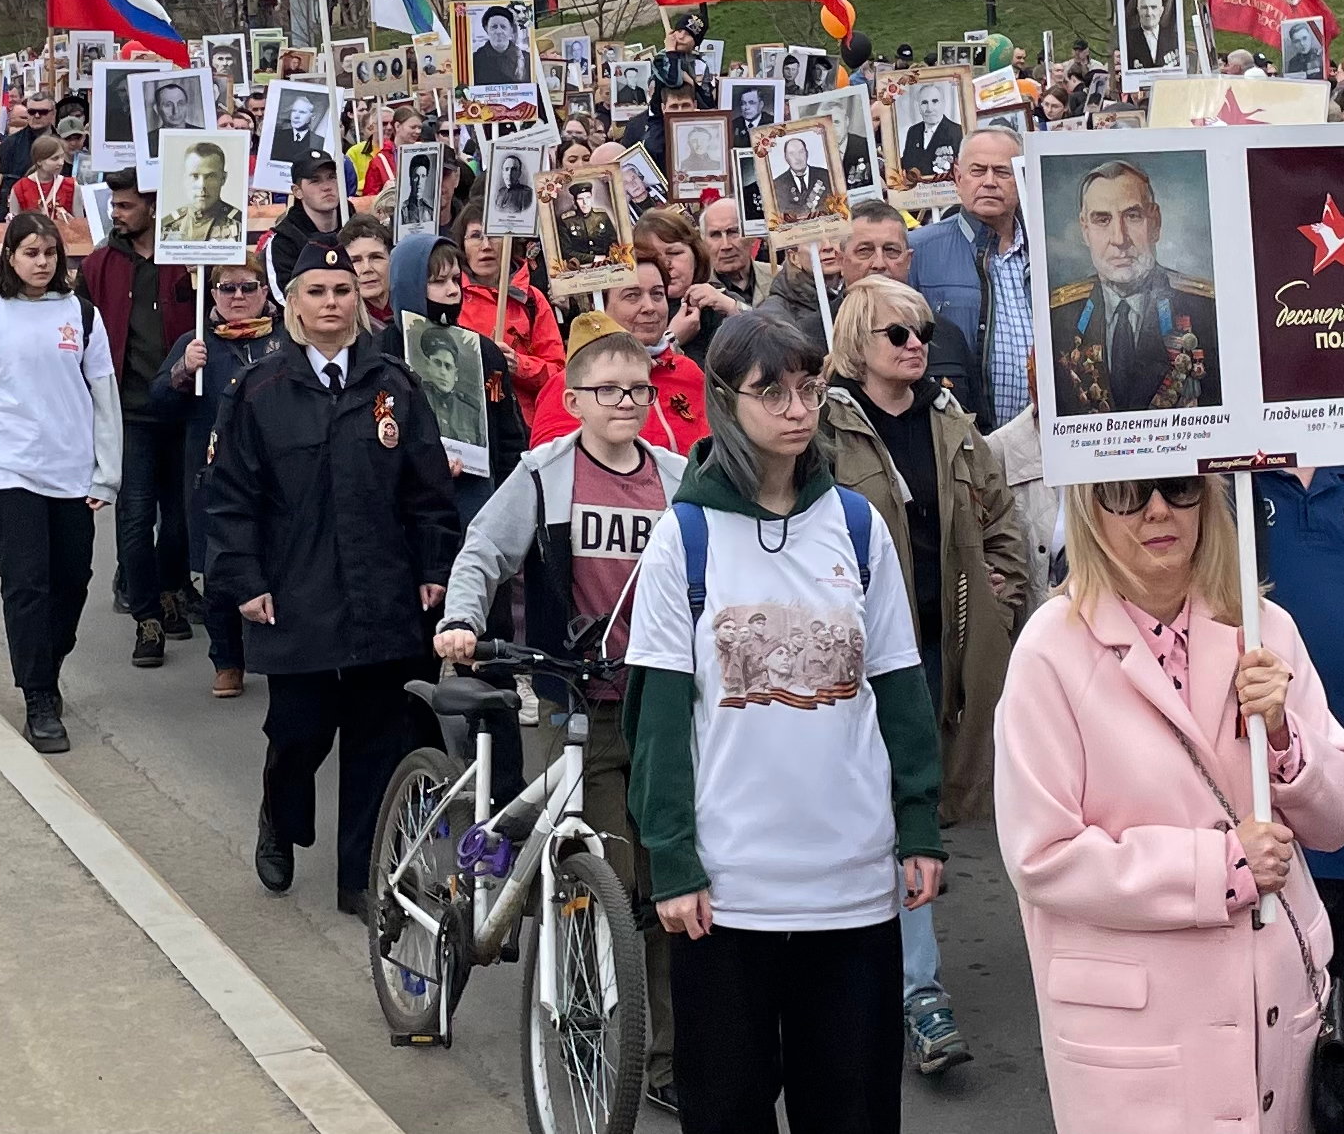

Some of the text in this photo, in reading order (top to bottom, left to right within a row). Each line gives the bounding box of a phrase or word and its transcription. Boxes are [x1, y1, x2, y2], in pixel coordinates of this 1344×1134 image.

[1263, 405, 1325, 422] Гладышев
[1052, 413, 1232, 436] Котенко Валентин Иванович
[1307, 422, 1325, 432] 1907
[1102, 435, 1123, 446] 1911
[1156, 442, 1188, 455] Службы
[580, 510, 661, 553] DAB
